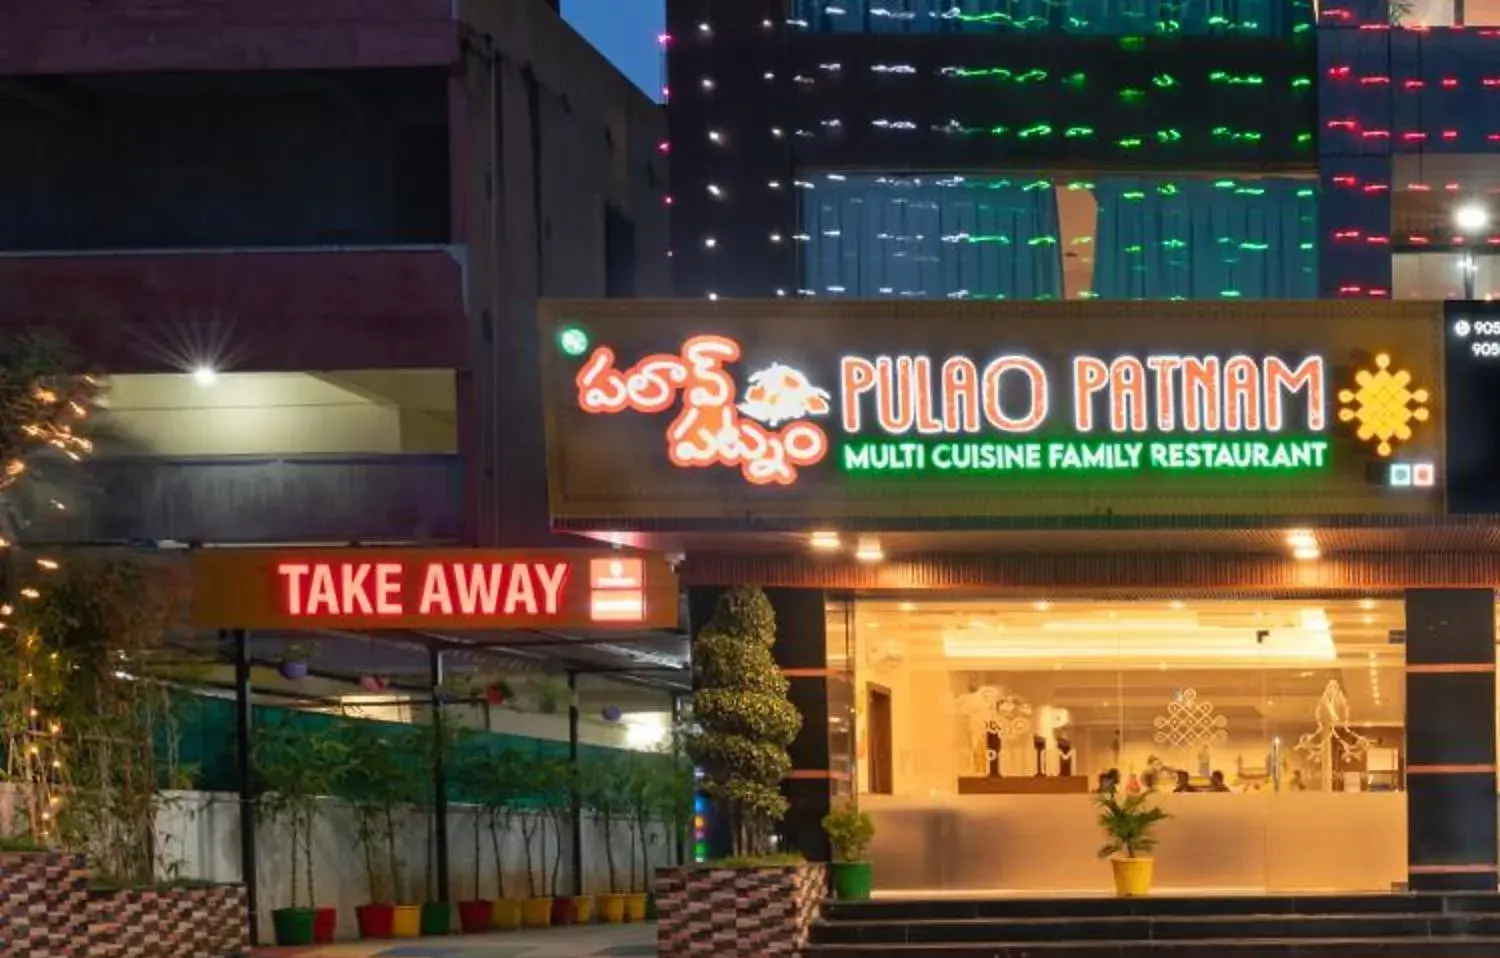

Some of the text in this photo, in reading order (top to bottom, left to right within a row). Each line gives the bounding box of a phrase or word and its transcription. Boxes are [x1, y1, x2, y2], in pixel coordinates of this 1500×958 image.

[841, 355, 1325, 433] PULAO PATNAM
[844, 442, 1328, 469] MULTI CUISINE FAMILY RESTAURANT
[279, 563, 567, 615] TAKE AWAY
